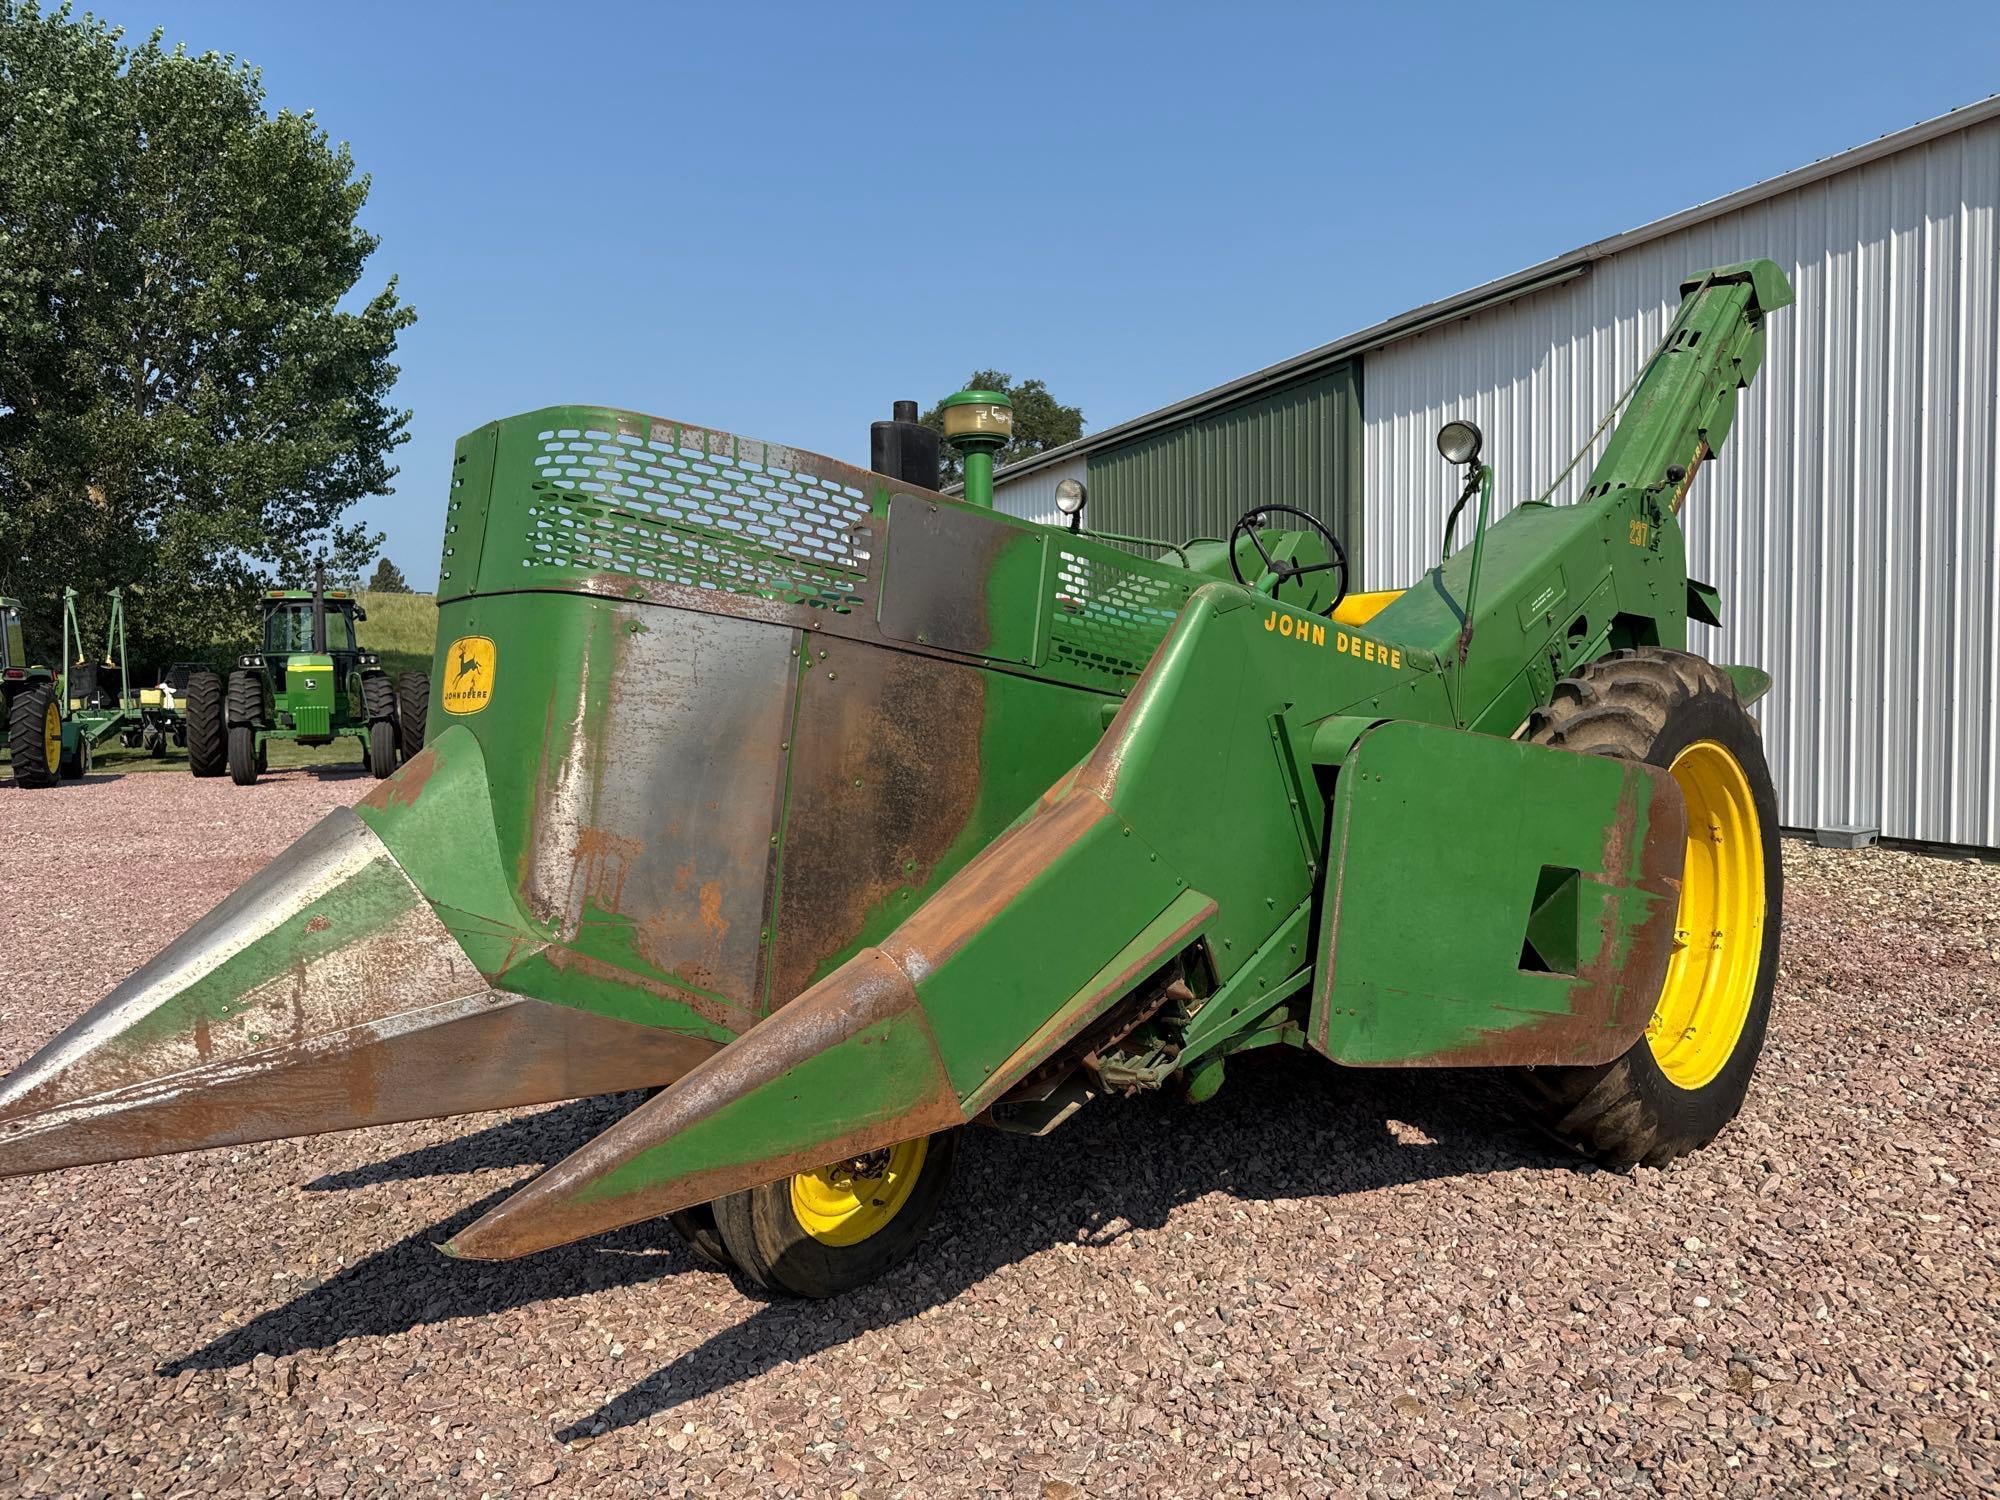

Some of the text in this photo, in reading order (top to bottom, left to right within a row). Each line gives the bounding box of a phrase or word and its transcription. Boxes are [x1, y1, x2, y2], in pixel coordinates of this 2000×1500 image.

[1629, 519, 1648, 547] 237
[1264, 610, 1401, 669] JOHN DEERE
[444, 690, 488, 700] JOHN DEERE
